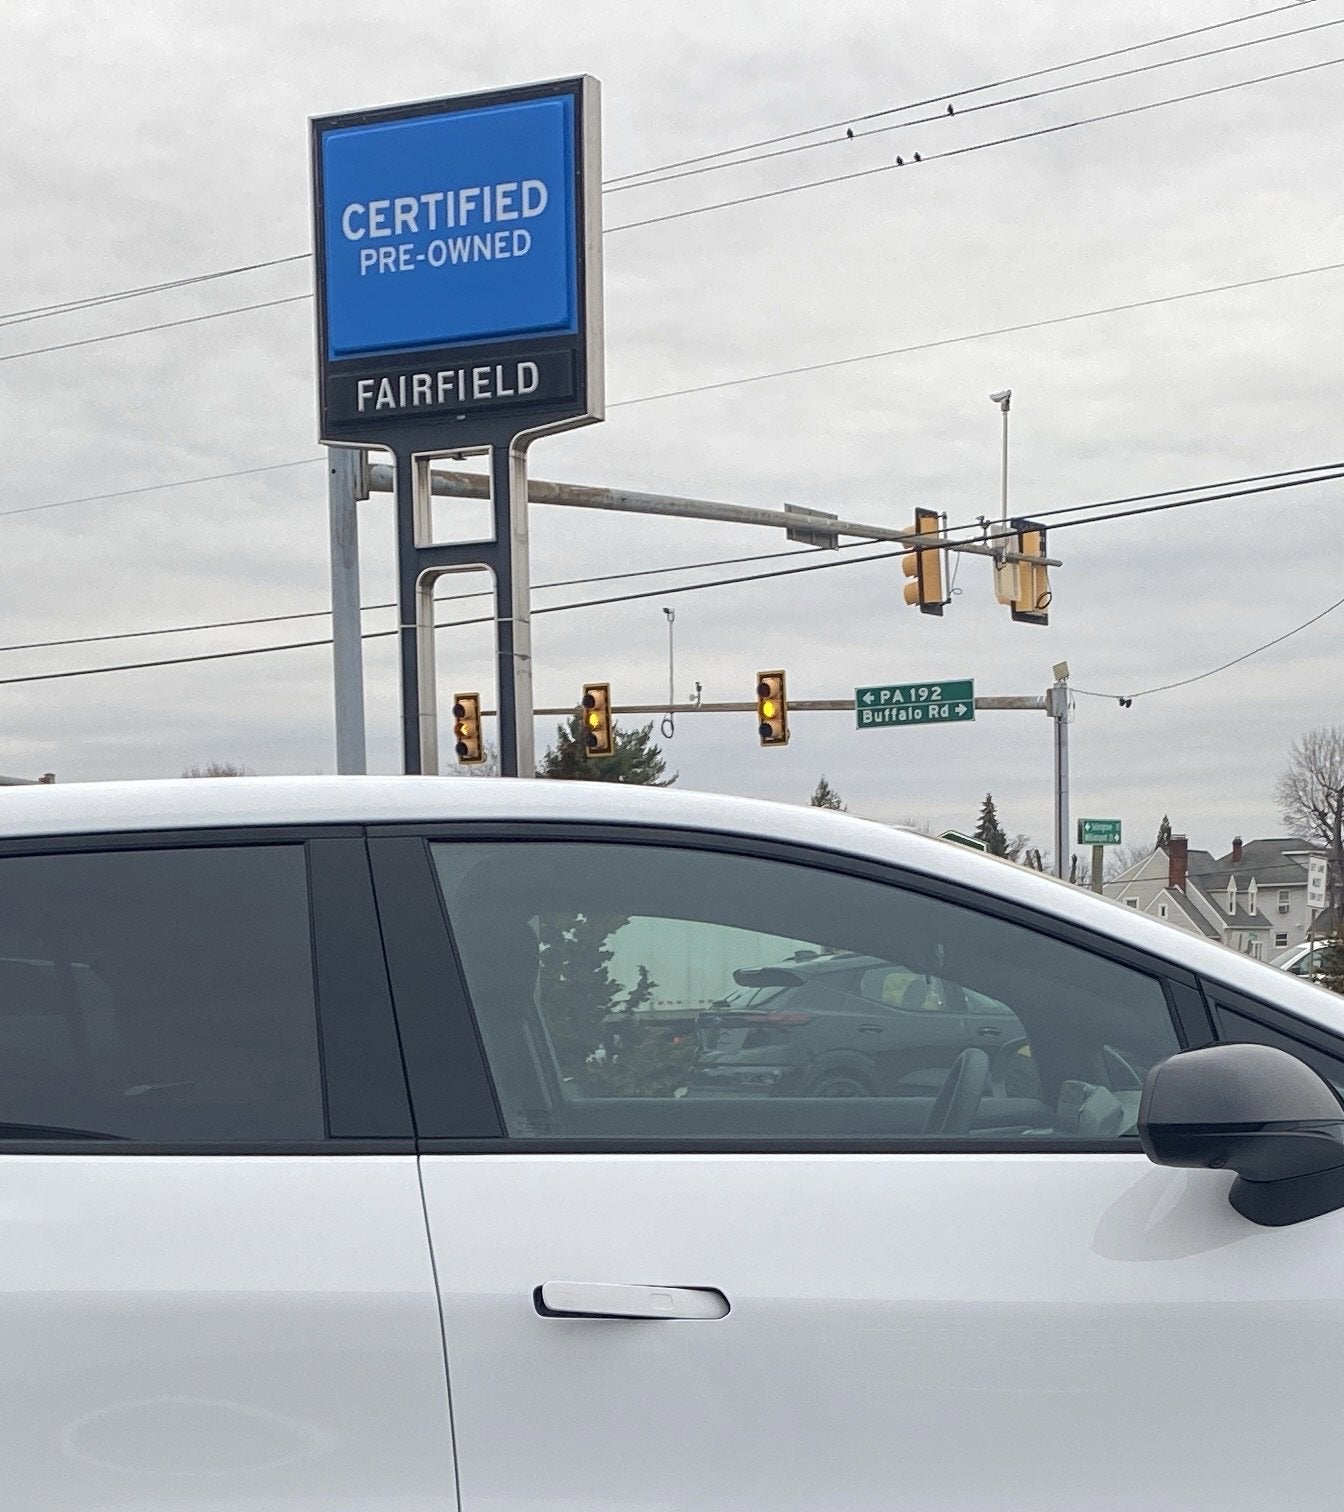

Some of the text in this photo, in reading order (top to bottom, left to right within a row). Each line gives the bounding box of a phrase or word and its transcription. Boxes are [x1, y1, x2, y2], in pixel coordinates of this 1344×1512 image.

[342, 179, 549, 241] CERTIFIED
[360, 229, 532, 276] PRE-OWNED
[357, 361, 539, 412] FAIRFIELD
[863, 704, 949, 723] Buffalo Rd
[880, 686, 942, 704] PA 192
